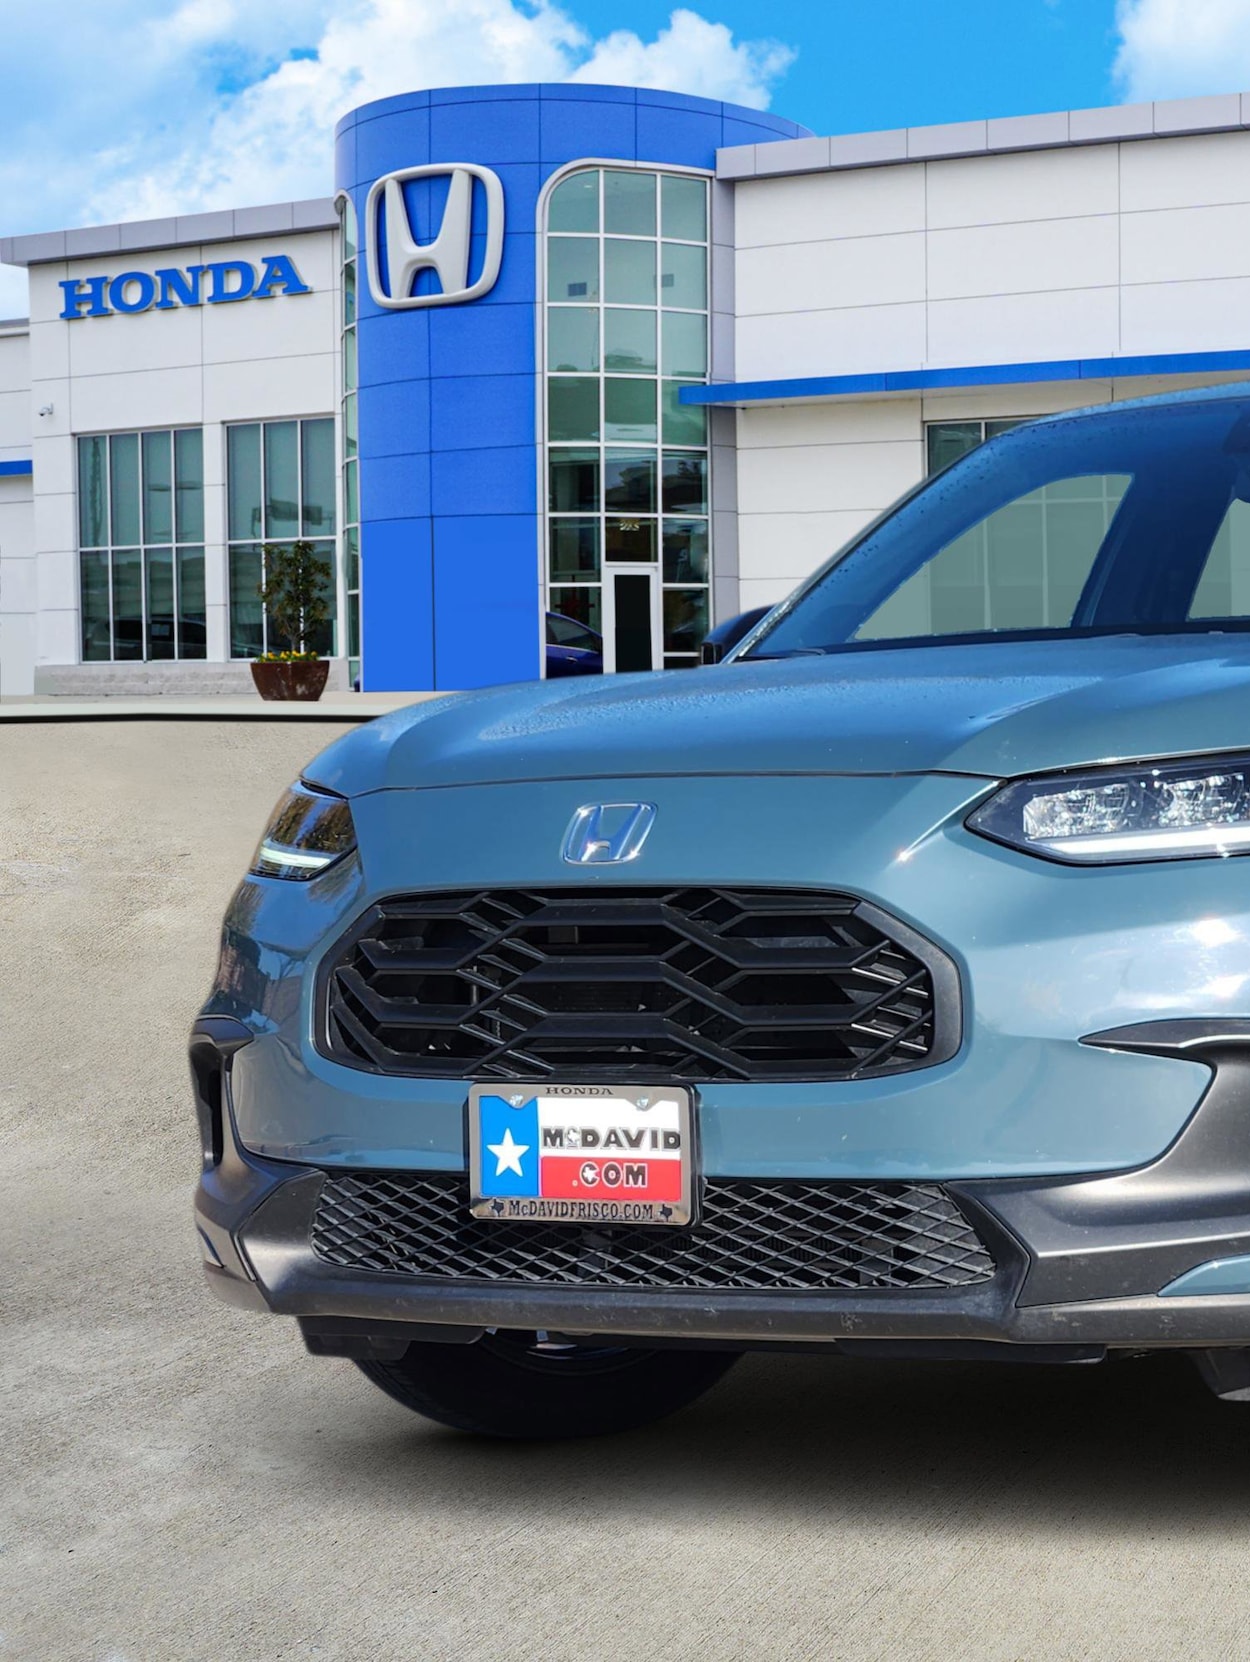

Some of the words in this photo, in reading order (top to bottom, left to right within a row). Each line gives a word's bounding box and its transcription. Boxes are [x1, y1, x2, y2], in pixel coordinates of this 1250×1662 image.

[59, 255, 309, 319] HONDA
[546, 1087, 614, 1096] HONDA
[572, 1161, 648, 1188] .COM
